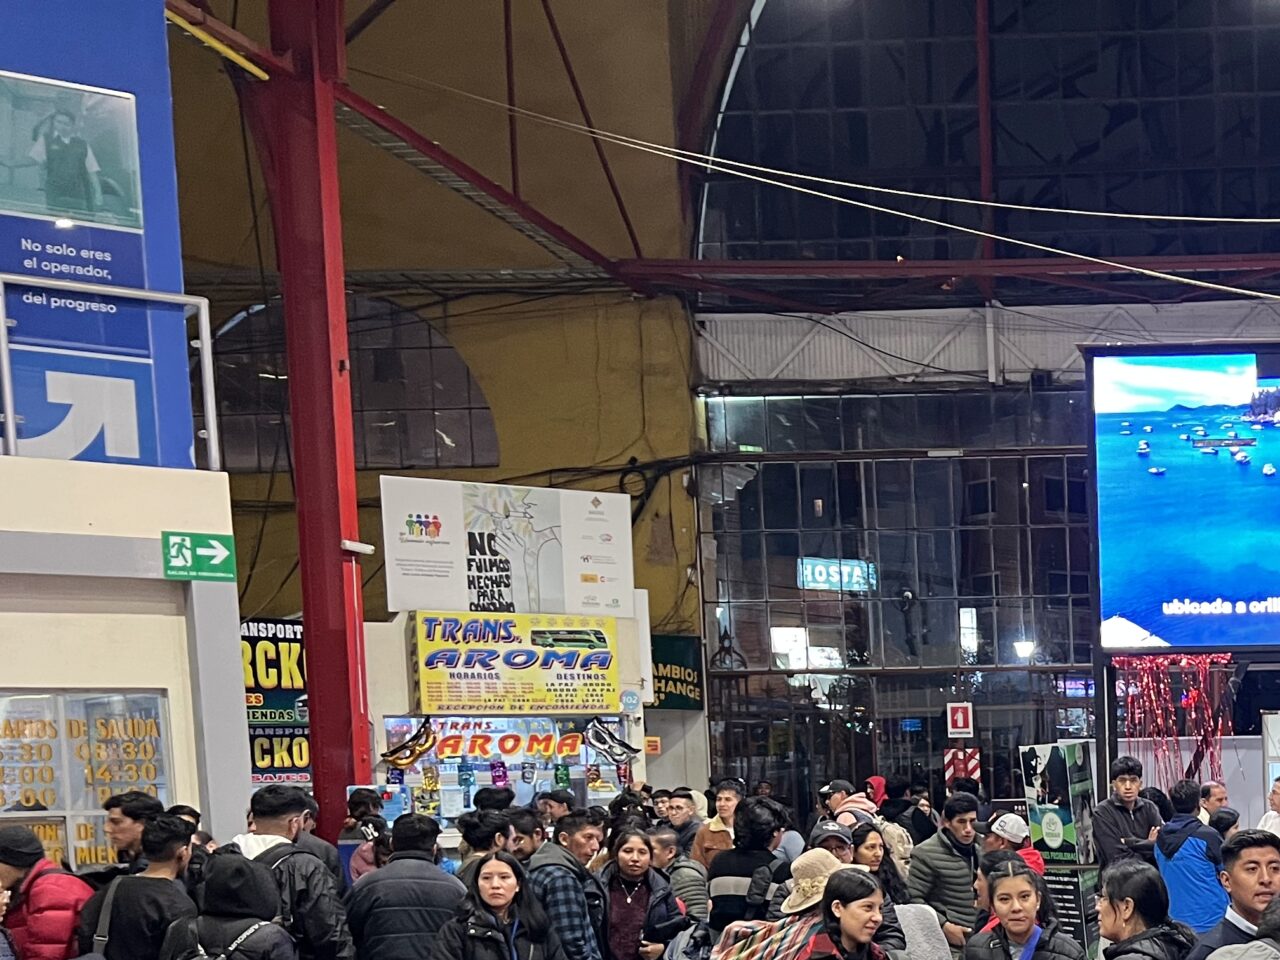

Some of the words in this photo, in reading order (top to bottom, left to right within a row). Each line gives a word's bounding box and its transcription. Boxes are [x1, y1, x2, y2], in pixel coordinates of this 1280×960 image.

[21, 238, 42, 251] No
[45, 244, 76, 256] solo
[80, 249, 112, 261] eres
[24, 257, 37, 269] el
[41, 261, 112, 280] operador,
[23, 292, 47, 305] del
[50, 297, 117, 313] progreso
[1162, 598, 1233, 615] ubicada
[1235, 601, 1247, 614] a
[423, 617, 522, 644] TRANS.
[424, 648, 613, 671] AROMA
[449, 672, 500, 680] HORARIOS
[622, 695, 638, 704] 102
[66, 719, 88, 739] DE
[95, 718, 161, 740] SALIDA
[438, 721, 498, 731] TRANS.
[437, 733, 583, 759] AROMA
[75, 823, 95, 841] DE
